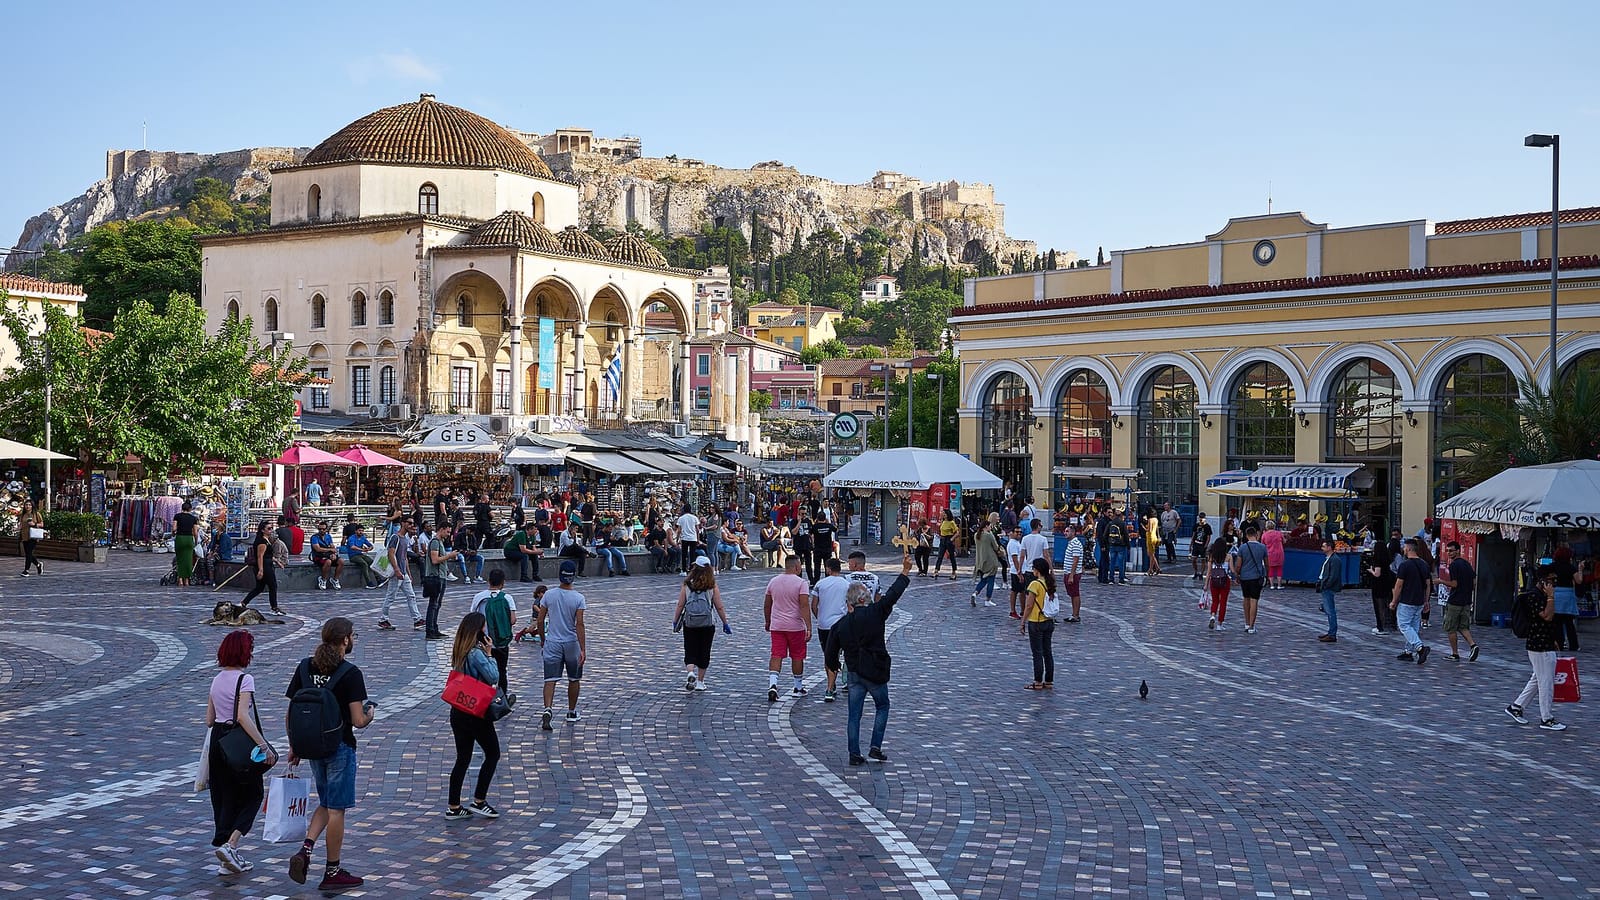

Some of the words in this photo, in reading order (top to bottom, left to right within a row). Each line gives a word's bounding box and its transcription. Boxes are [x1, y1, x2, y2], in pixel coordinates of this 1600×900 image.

[441, 429, 476, 442] GES
[456, 691, 478, 710] BSB
[287, 797, 307, 817] H&M
